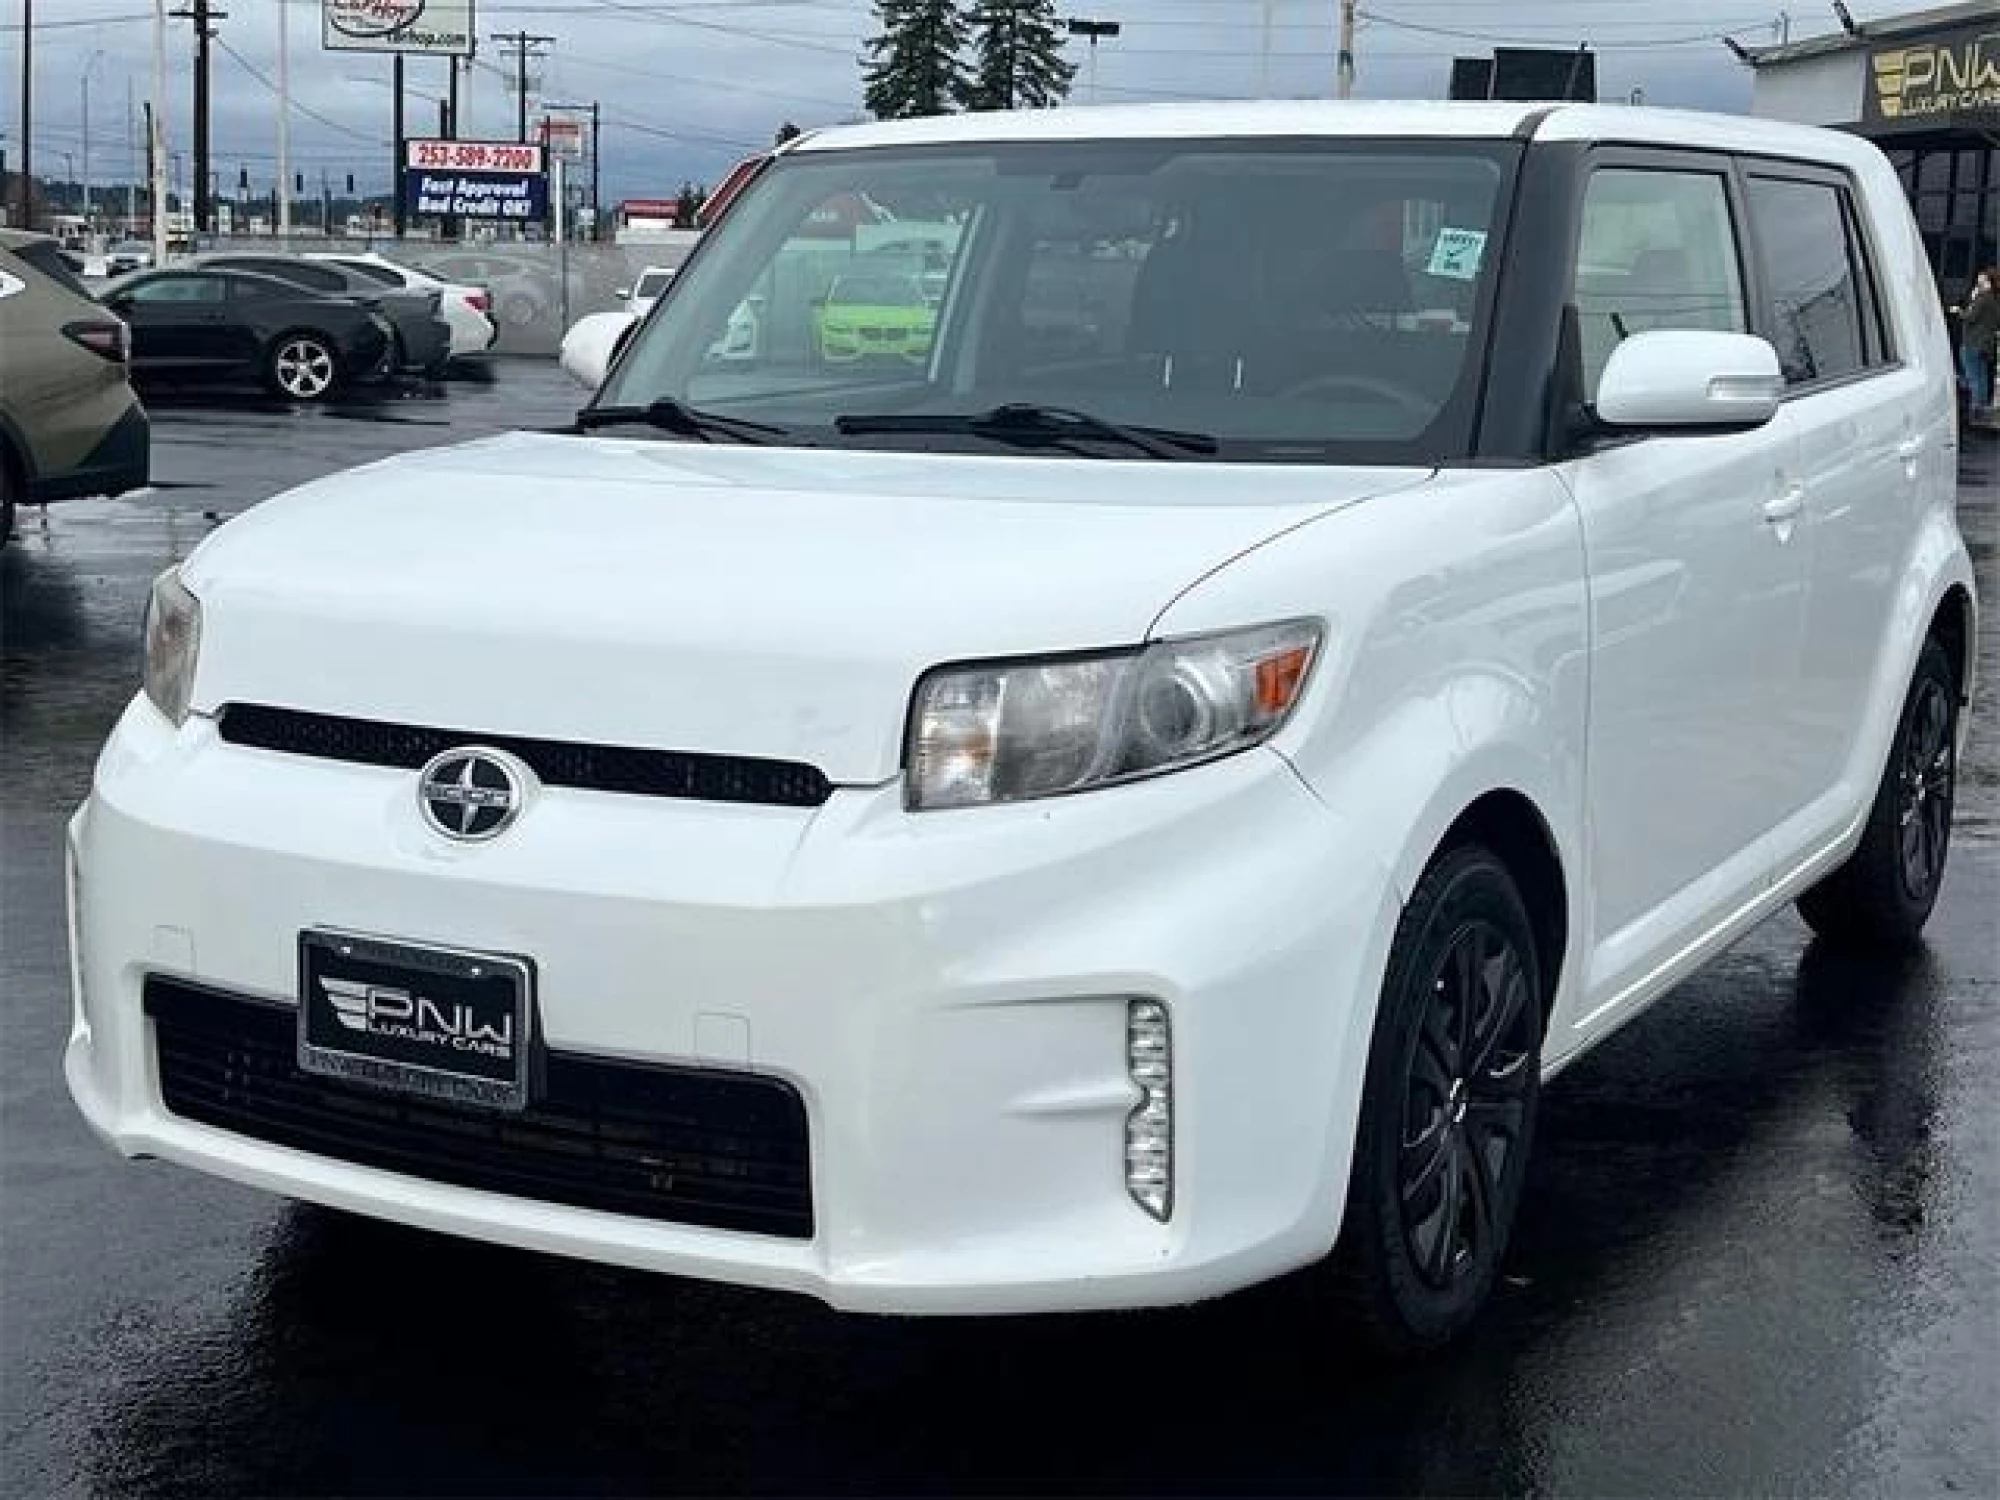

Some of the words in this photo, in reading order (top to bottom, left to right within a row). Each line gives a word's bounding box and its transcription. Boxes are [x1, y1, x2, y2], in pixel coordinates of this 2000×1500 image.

[1902, 43, 2000, 98] PNW
[1902, 93, 1957, 116] LUXURY
[418, 144, 532, 169] 253-589-2200
[421, 176, 454, 193] Fast
[456, 178, 529, 198] Approval
[418, 197, 451, 213] Bad
[453, 197, 500, 215] Credit
[369, 987, 512, 1045] PNW
[367, 1021, 448, 1046] LUXURY
[452, 1037, 512, 1059] CARS
